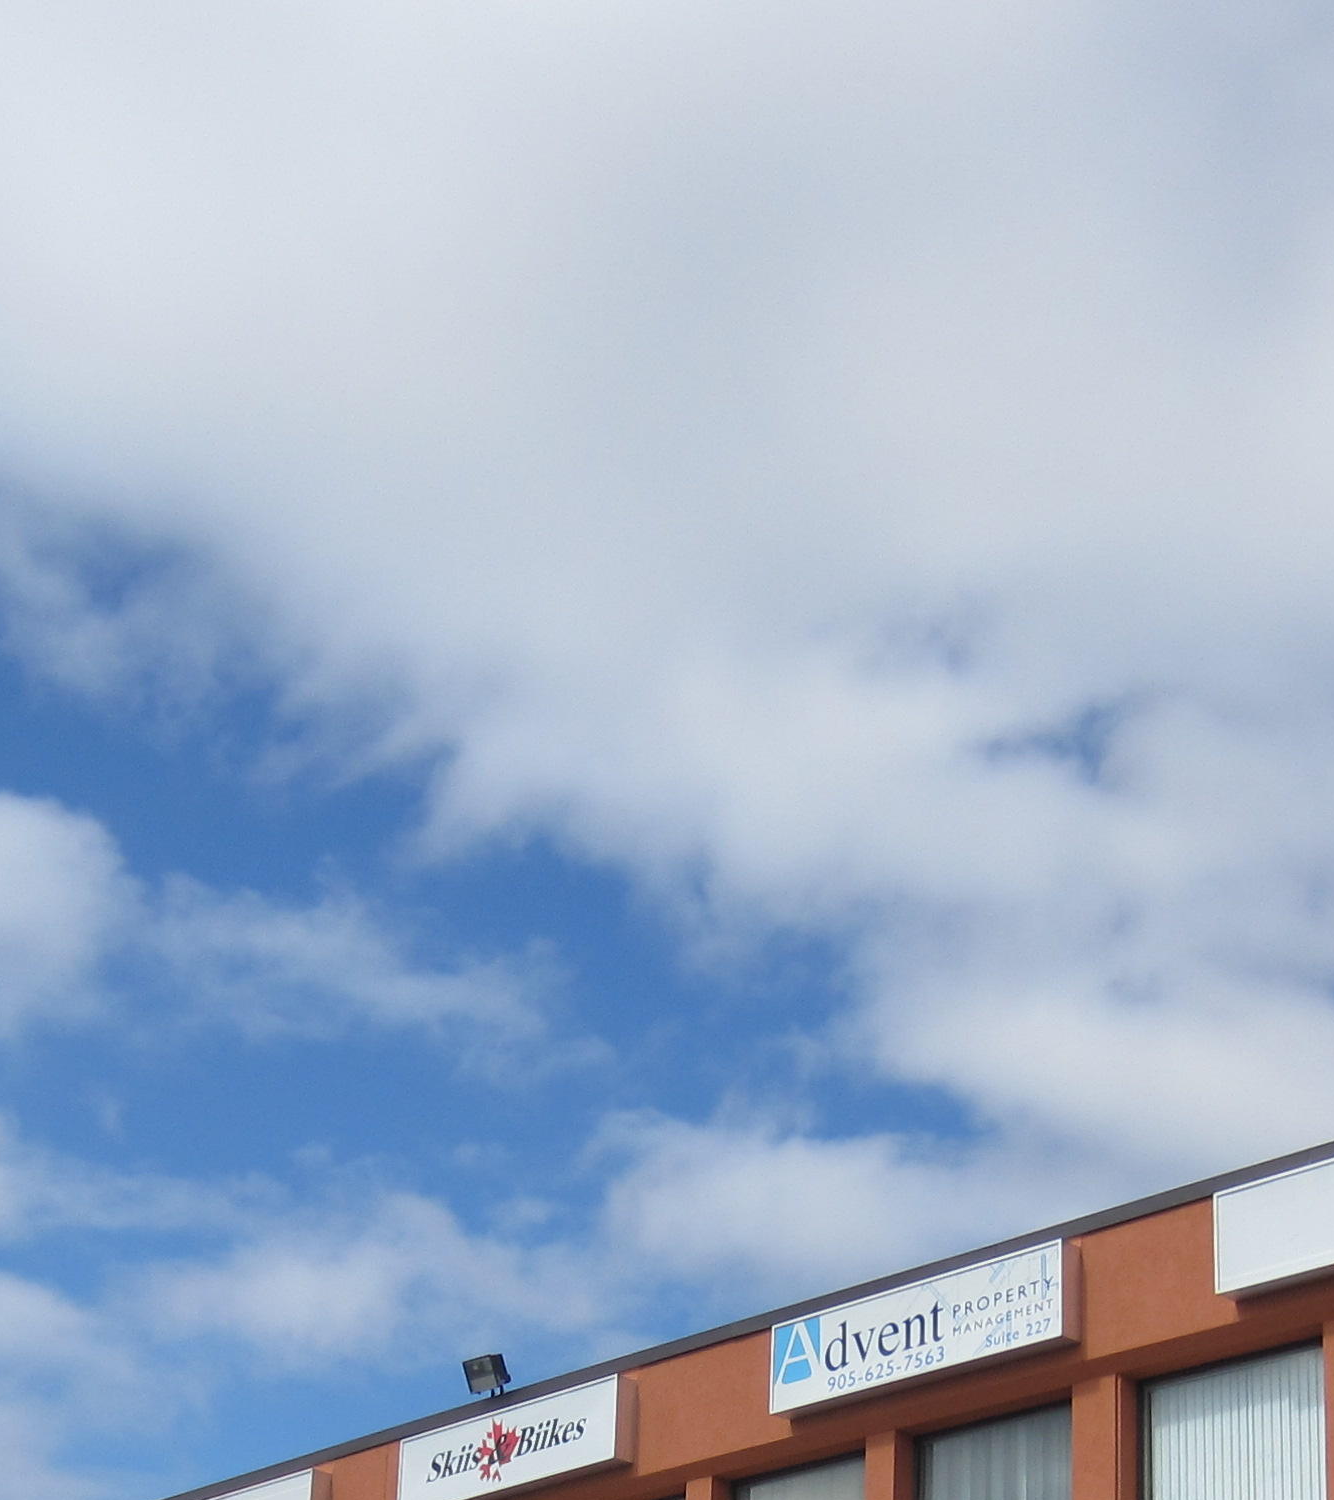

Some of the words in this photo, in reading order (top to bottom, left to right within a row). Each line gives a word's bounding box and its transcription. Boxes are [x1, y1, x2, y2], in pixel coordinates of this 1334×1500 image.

[953, 1276, 1053, 1319] PROPERTY
[953, 1299, 1053, 1336] MANAGEMENT
[774, 1300, 944, 1385] Advent
[986, 1331, 1020, 1347] Suite
[1026, 1318, 1051, 1336] 227
[827, 1346, 946, 1392] 905-625-7563
[426, 1442, 482, 1483] Skiis
[488, 1433, 511, 1465] &
[514, 1417, 588, 1458] Biikes
